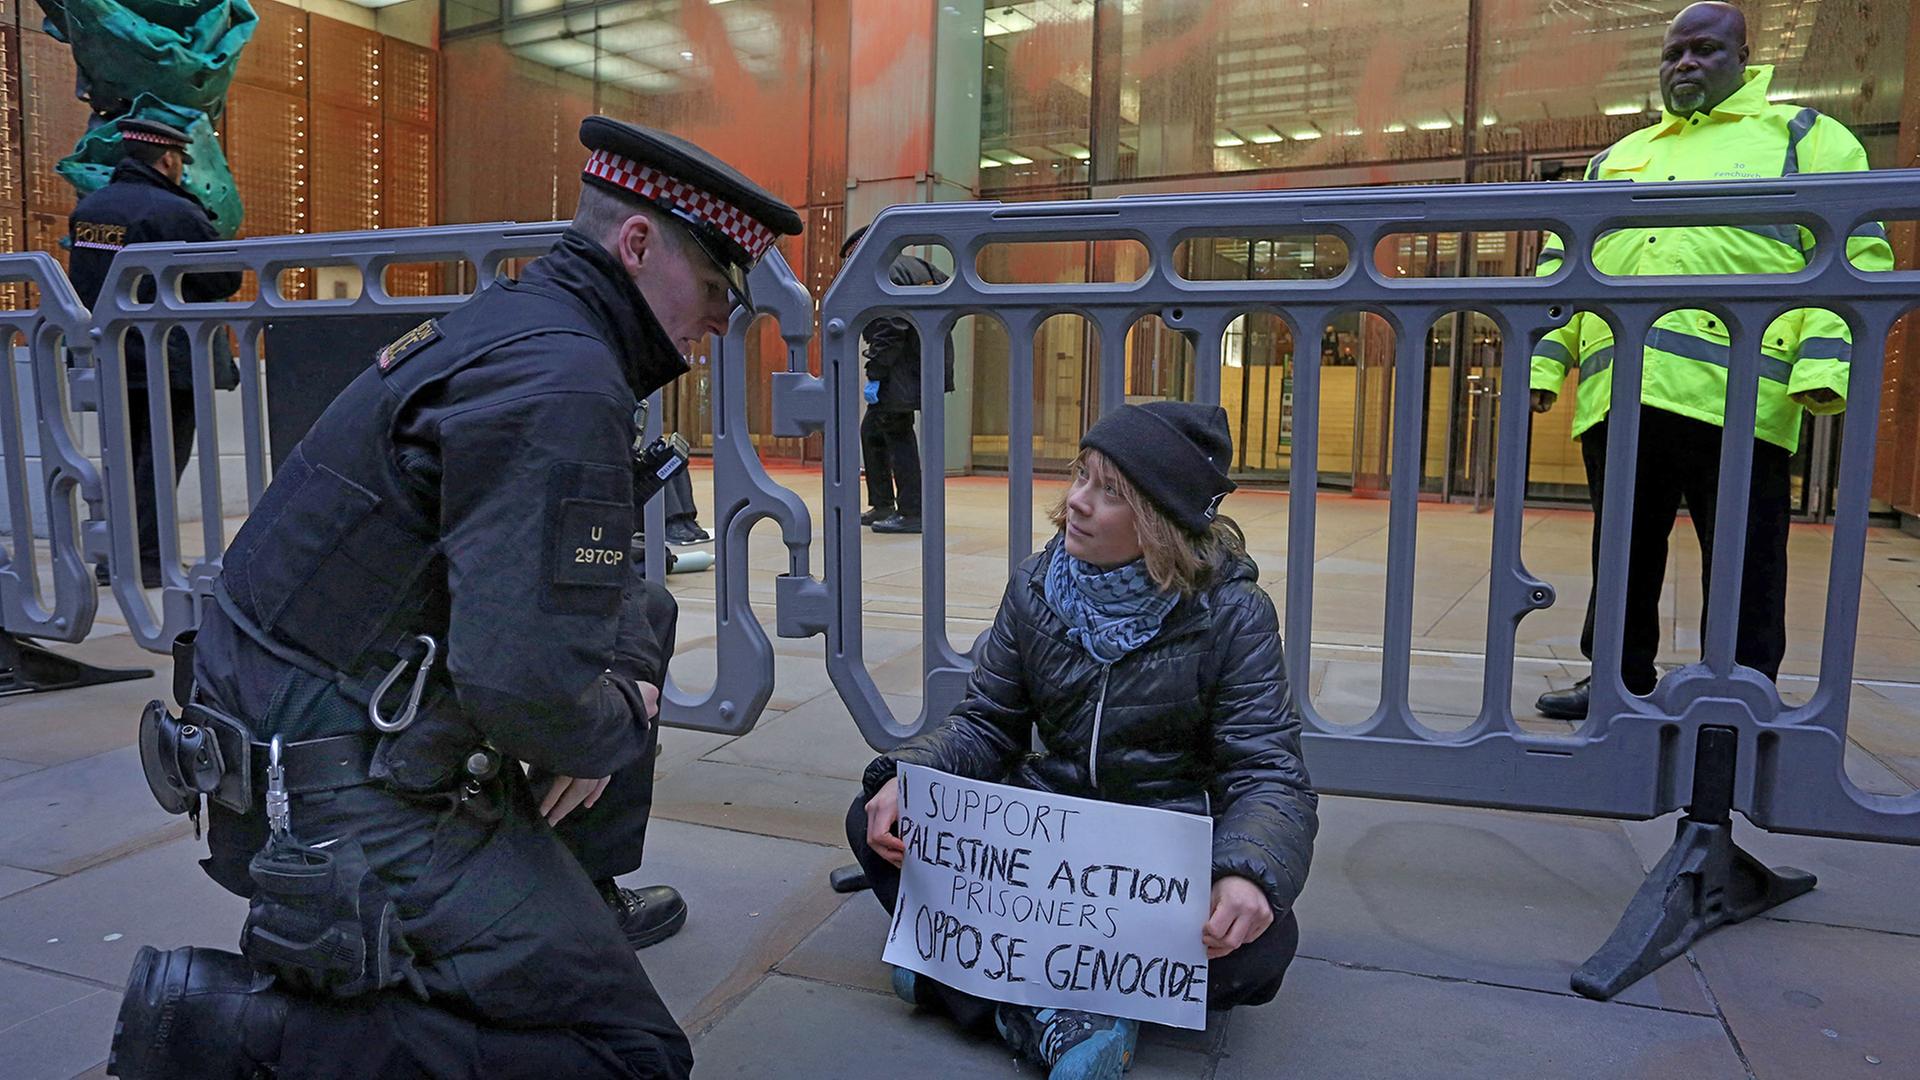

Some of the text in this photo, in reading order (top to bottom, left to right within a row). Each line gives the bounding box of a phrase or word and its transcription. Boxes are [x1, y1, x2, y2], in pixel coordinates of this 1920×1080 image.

[76, 227, 126, 246] POLICE
[575, 547, 624, 566] 297CP
[591, 526, 602, 541] U
[902, 771, 1080, 842] I SUPPORT
[899, 815, 1190, 905] PALESTINE ACTION
[951, 875, 1119, 938] PRISONERS
[915, 904, 1028, 983] OPPOSE
[1045, 943, 1208, 1003] GENOCIDE
